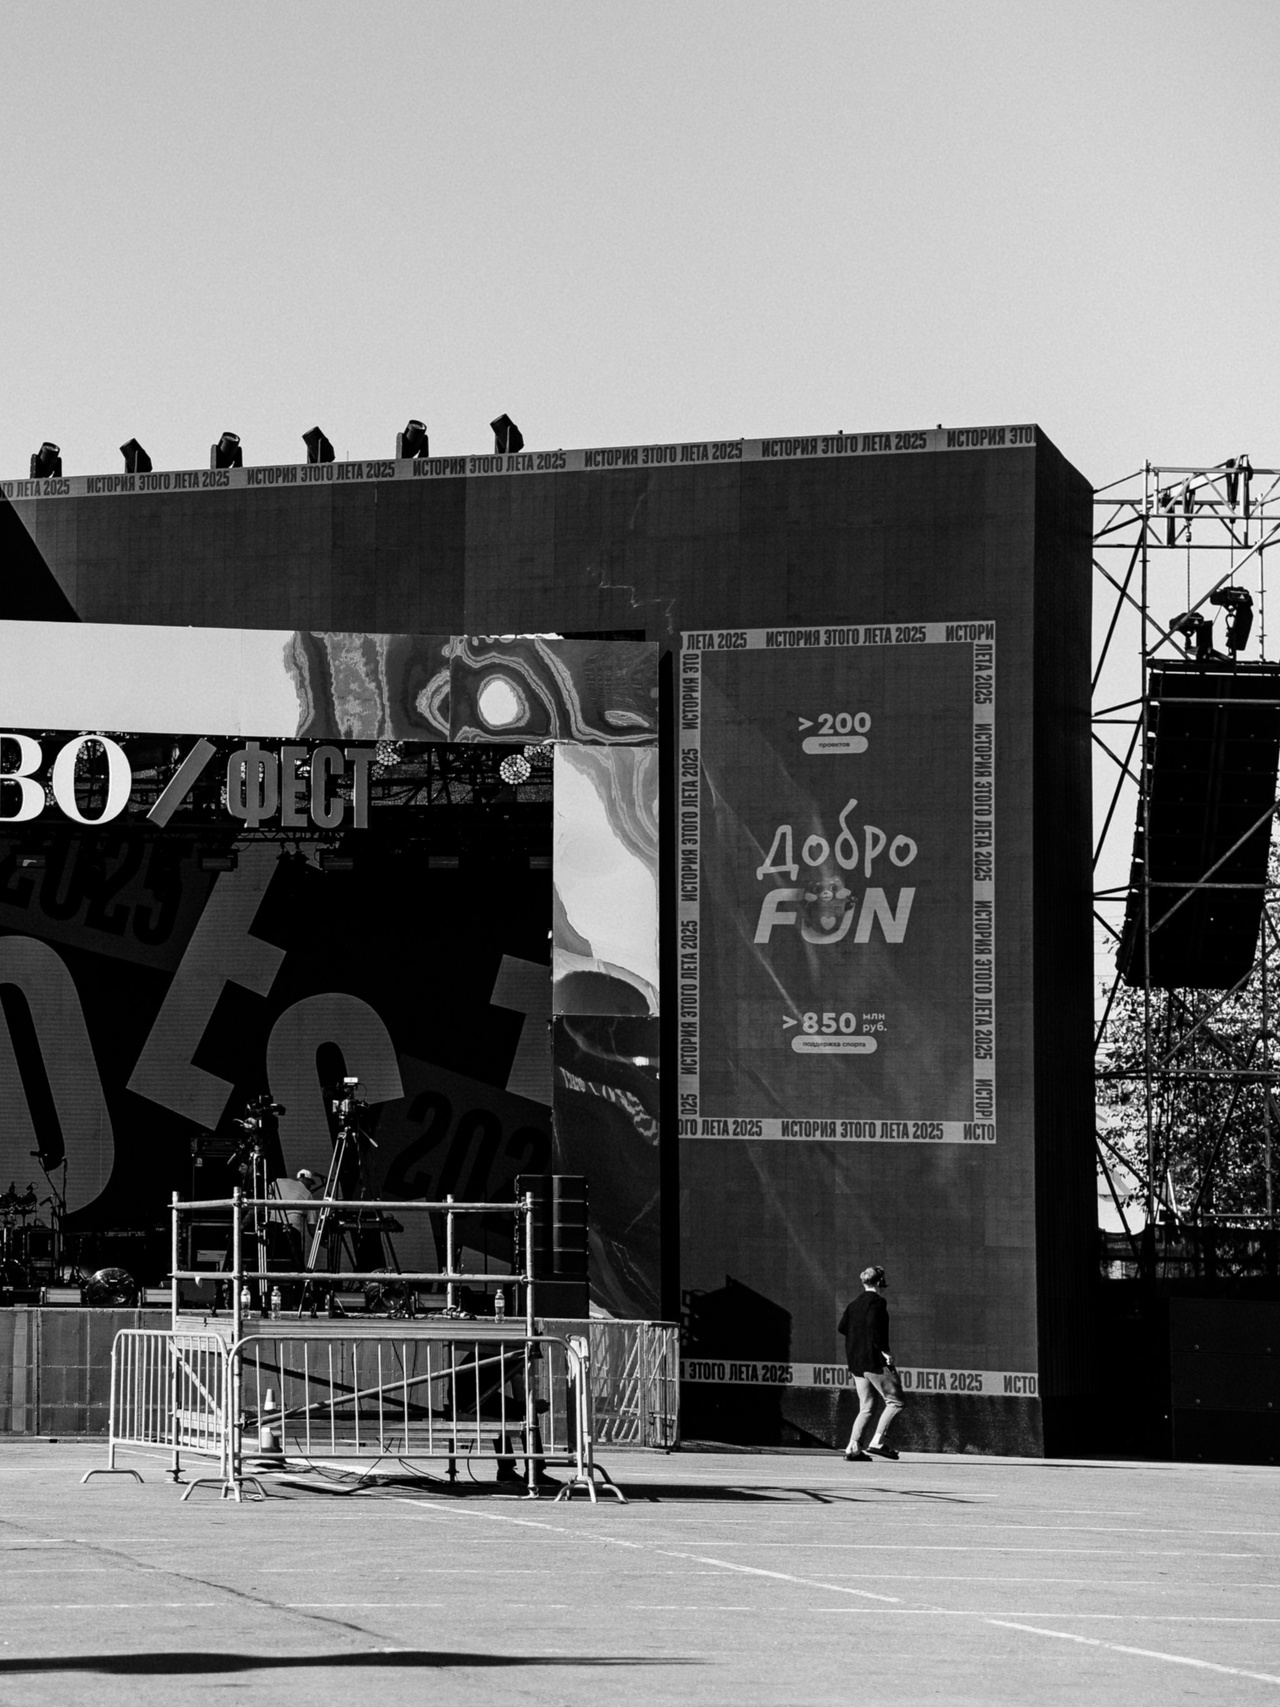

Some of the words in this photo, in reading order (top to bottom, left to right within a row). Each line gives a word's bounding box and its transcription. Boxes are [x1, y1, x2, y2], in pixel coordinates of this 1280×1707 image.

[17, 480, 41, 497] ЛЕТА
[43, 479, 70, 496] 2025
[86, 475, 135, 493] ИСТОРИЯ
[139, 473, 170, 491] ЭТОГО
[174, 472, 199, 489] ЛЕТА
[202, 470, 229, 487] 2025
[247, 466, 297, 485] ИСТОРИЯ
[300, 464, 333, 482] ЭТОГО
[337, 463, 363, 480] ЛЕТА
[366, 461, 395, 478] 2025
[413, 457, 466, 476] ИСТОРИЯ
[469, 456, 503, 474] ЭТОГО
[507, 454, 534, 472] ЛЕТА
[537, 452, 566, 470] 2025
[584, 448, 638, 467] ИСТОРИЯ
[642, 445, 677, 464] ЭТОГО
[681, 444, 708, 462] ЛЕТА
[712, 442, 742, 460] 2025
[761, 437, 817, 457] ИСТОРИЯ
[821, 435, 858, 454] ЭТОГО
[862, 433, 891, 452] ЛЕТА
[895, 431, 926, 450] 2025
[947, 427, 1005, 448] ИСТОРИЯ
[687, 633, 714, 650] ЛЕТА
[717, 632, 747, 649] 2025
[765, 629, 820, 647] ИСТОРИЯ
[824, 628, 859, 646] ЭТОГО
[863, 627, 892, 644] ЛЕТА
[895, 625, 926, 643] 2025
[682, 653, 699, 674] ЭТО
[974, 644, 993, 671] ЛЕТА
[682, 677, 699, 730] ИСТОРИЯ
[974, 674, 992, 704] 2025
[681, 748, 698, 777] 2025
[974, 723, 992, 777] ИСТОРИЯ
[226, 741, 377, 830] ФЕСТ
[681, 780, 698, 808] ЛЕТА
[975, 781, 992, 816] ЭТОГО
[681, 811, 698, 845] ЭТОГО
[756, 799, 917, 882] Добро
[975, 820, 992, 848] ЛЕТА
[681, 849, 698, 901] ИСТОРИЯ
[975, 851, 992, 881] 2025
[754, 888, 915, 945] FUN
[975, 900, 992, 955] ИСТОРИЯ
[680, 920, 698, 949] 2025
[680, 952, 697, 980] ЛЕТА
[975, 958, 992, 994] ЭТОГО
[680, 983, 697, 1018] ЭТОГО
[975, 998, 992, 1026] ЛЕТА
[863, 1021, 888, 1033] руб.
[680, 1021, 697, 1075] ИСТОРИЯ
[842, 1041, 866, 1049] спорта
[975, 1029, 993, 1059] 2025
[701, 1119, 729, 1136] ЛЕТА
[732, 1119, 762, 1136] 2025
[781, 1120, 836, 1138] ИСТОРИЯ
[840, 1121, 876, 1138] ЭТОГО
[879, 1122, 909, 1139] ЛЕТА
[912, 1122, 943, 1140] 2025
[963, 1123, 997, 1141] ИСТО
[689, 1361, 725, 1380] ЭТОГО
[729, 1363, 758, 1382] ЛЕТА
[761, 1364, 793, 1384] 2025
[915, 1371, 947, 1390] ЛЕТА
[950, 1372, 982, 1392] 2025
[1003, 1375, 1039, 1394] ИСТО
